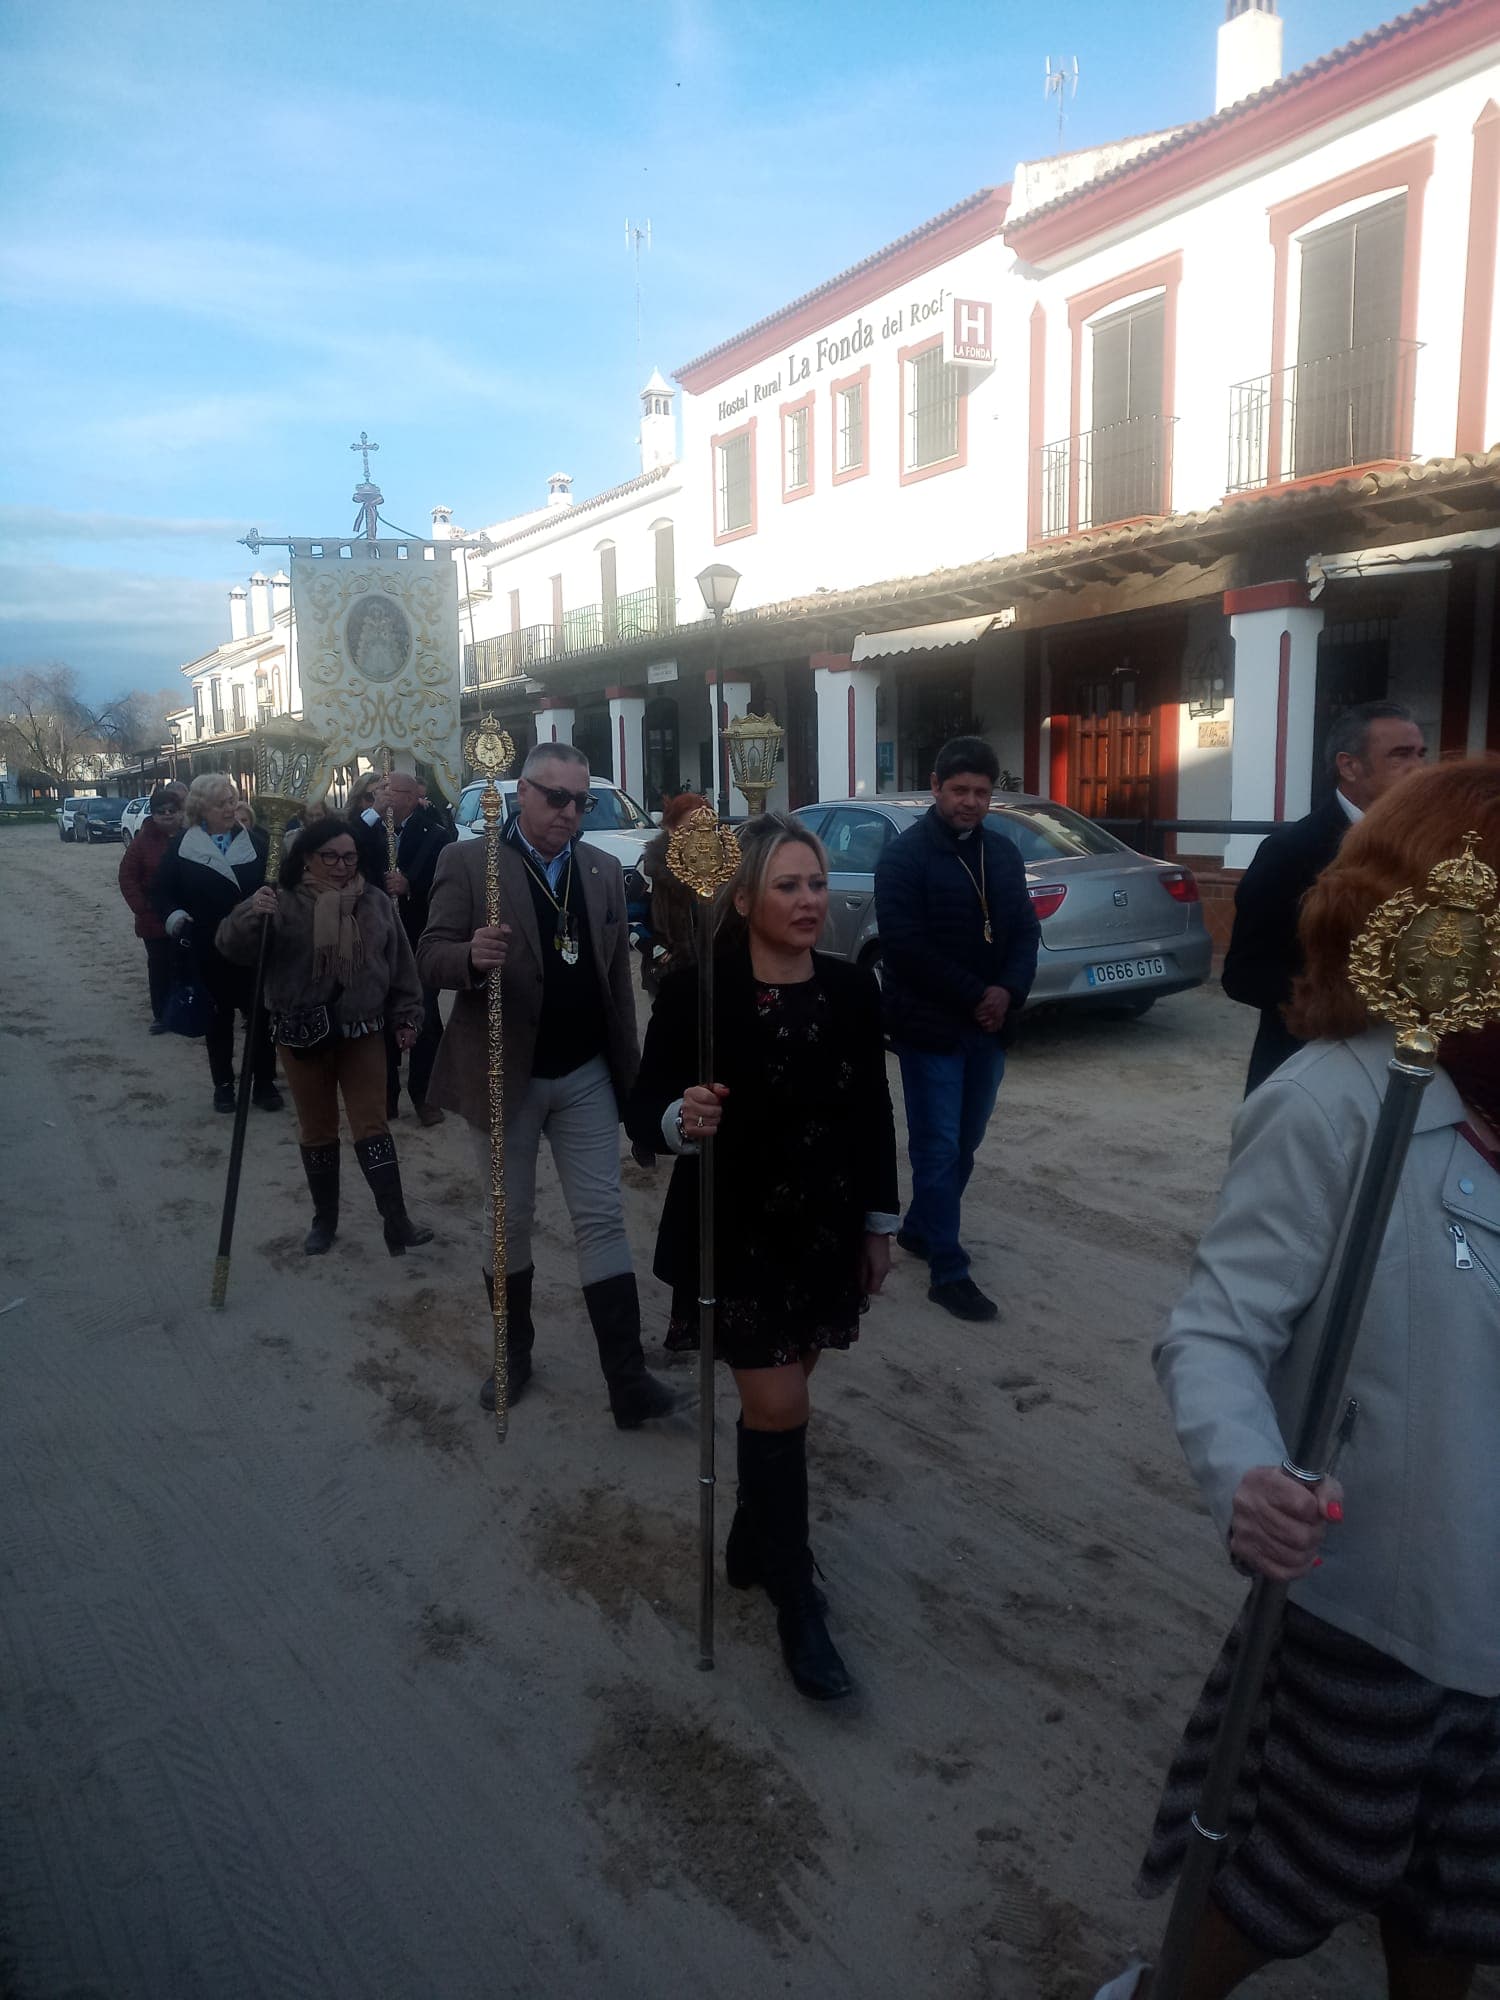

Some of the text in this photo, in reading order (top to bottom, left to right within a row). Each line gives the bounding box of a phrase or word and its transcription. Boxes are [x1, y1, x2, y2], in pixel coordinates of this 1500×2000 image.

[961, 304, 985, 345] H
[718, 288, 952, 421] Hostal Rural La Fonda del Rocí
[954, 344, 991, 360] LA FONDA
[1096, 958, 1163, 982] 0666 GTG
